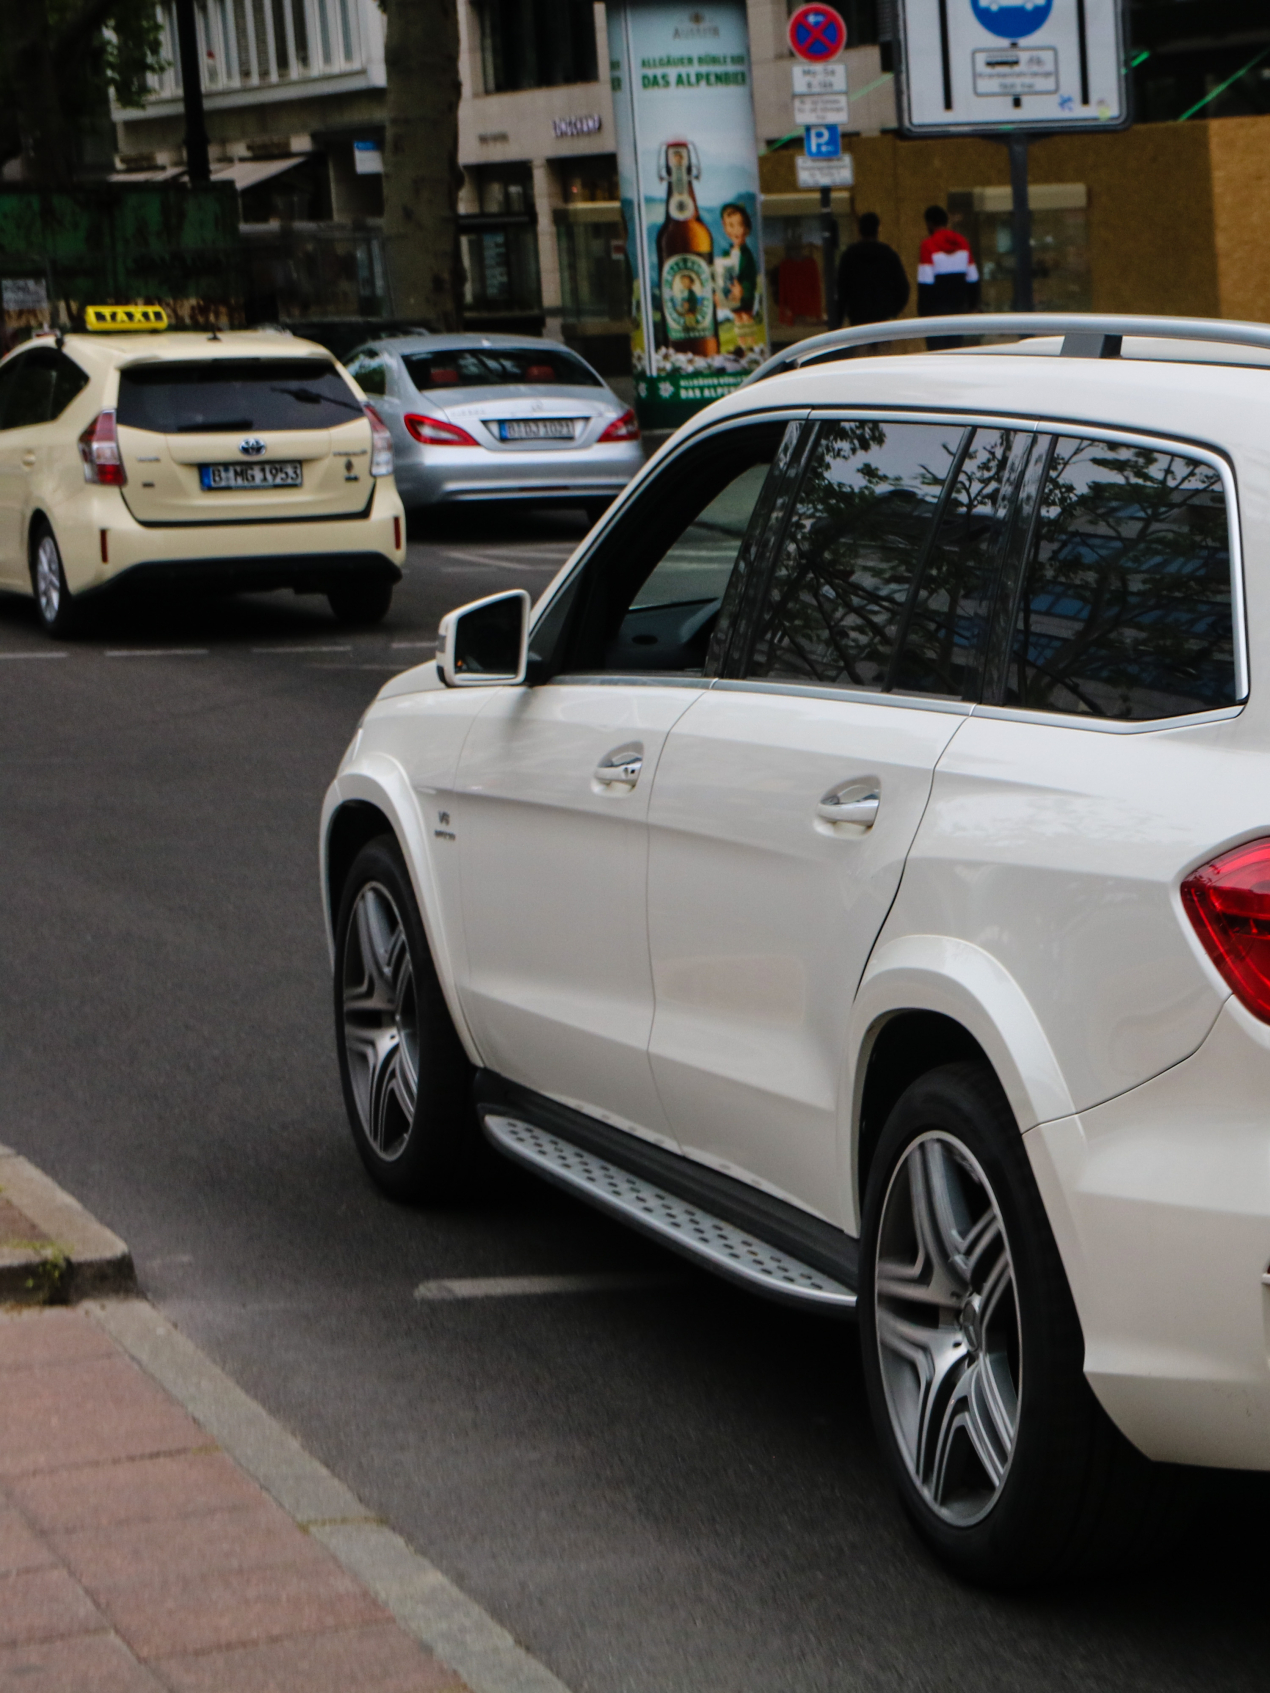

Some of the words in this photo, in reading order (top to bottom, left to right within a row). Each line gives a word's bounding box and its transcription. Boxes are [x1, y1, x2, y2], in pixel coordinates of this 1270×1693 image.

[641, 73, 670, 89] DAS
[810, 126, 829, 154] P
[103, 311, 156, 323] TAXI
[212, 467, 223, 485] B
[234, 466, 255, 483] MG
[260, 464, 300, 482] 1953
